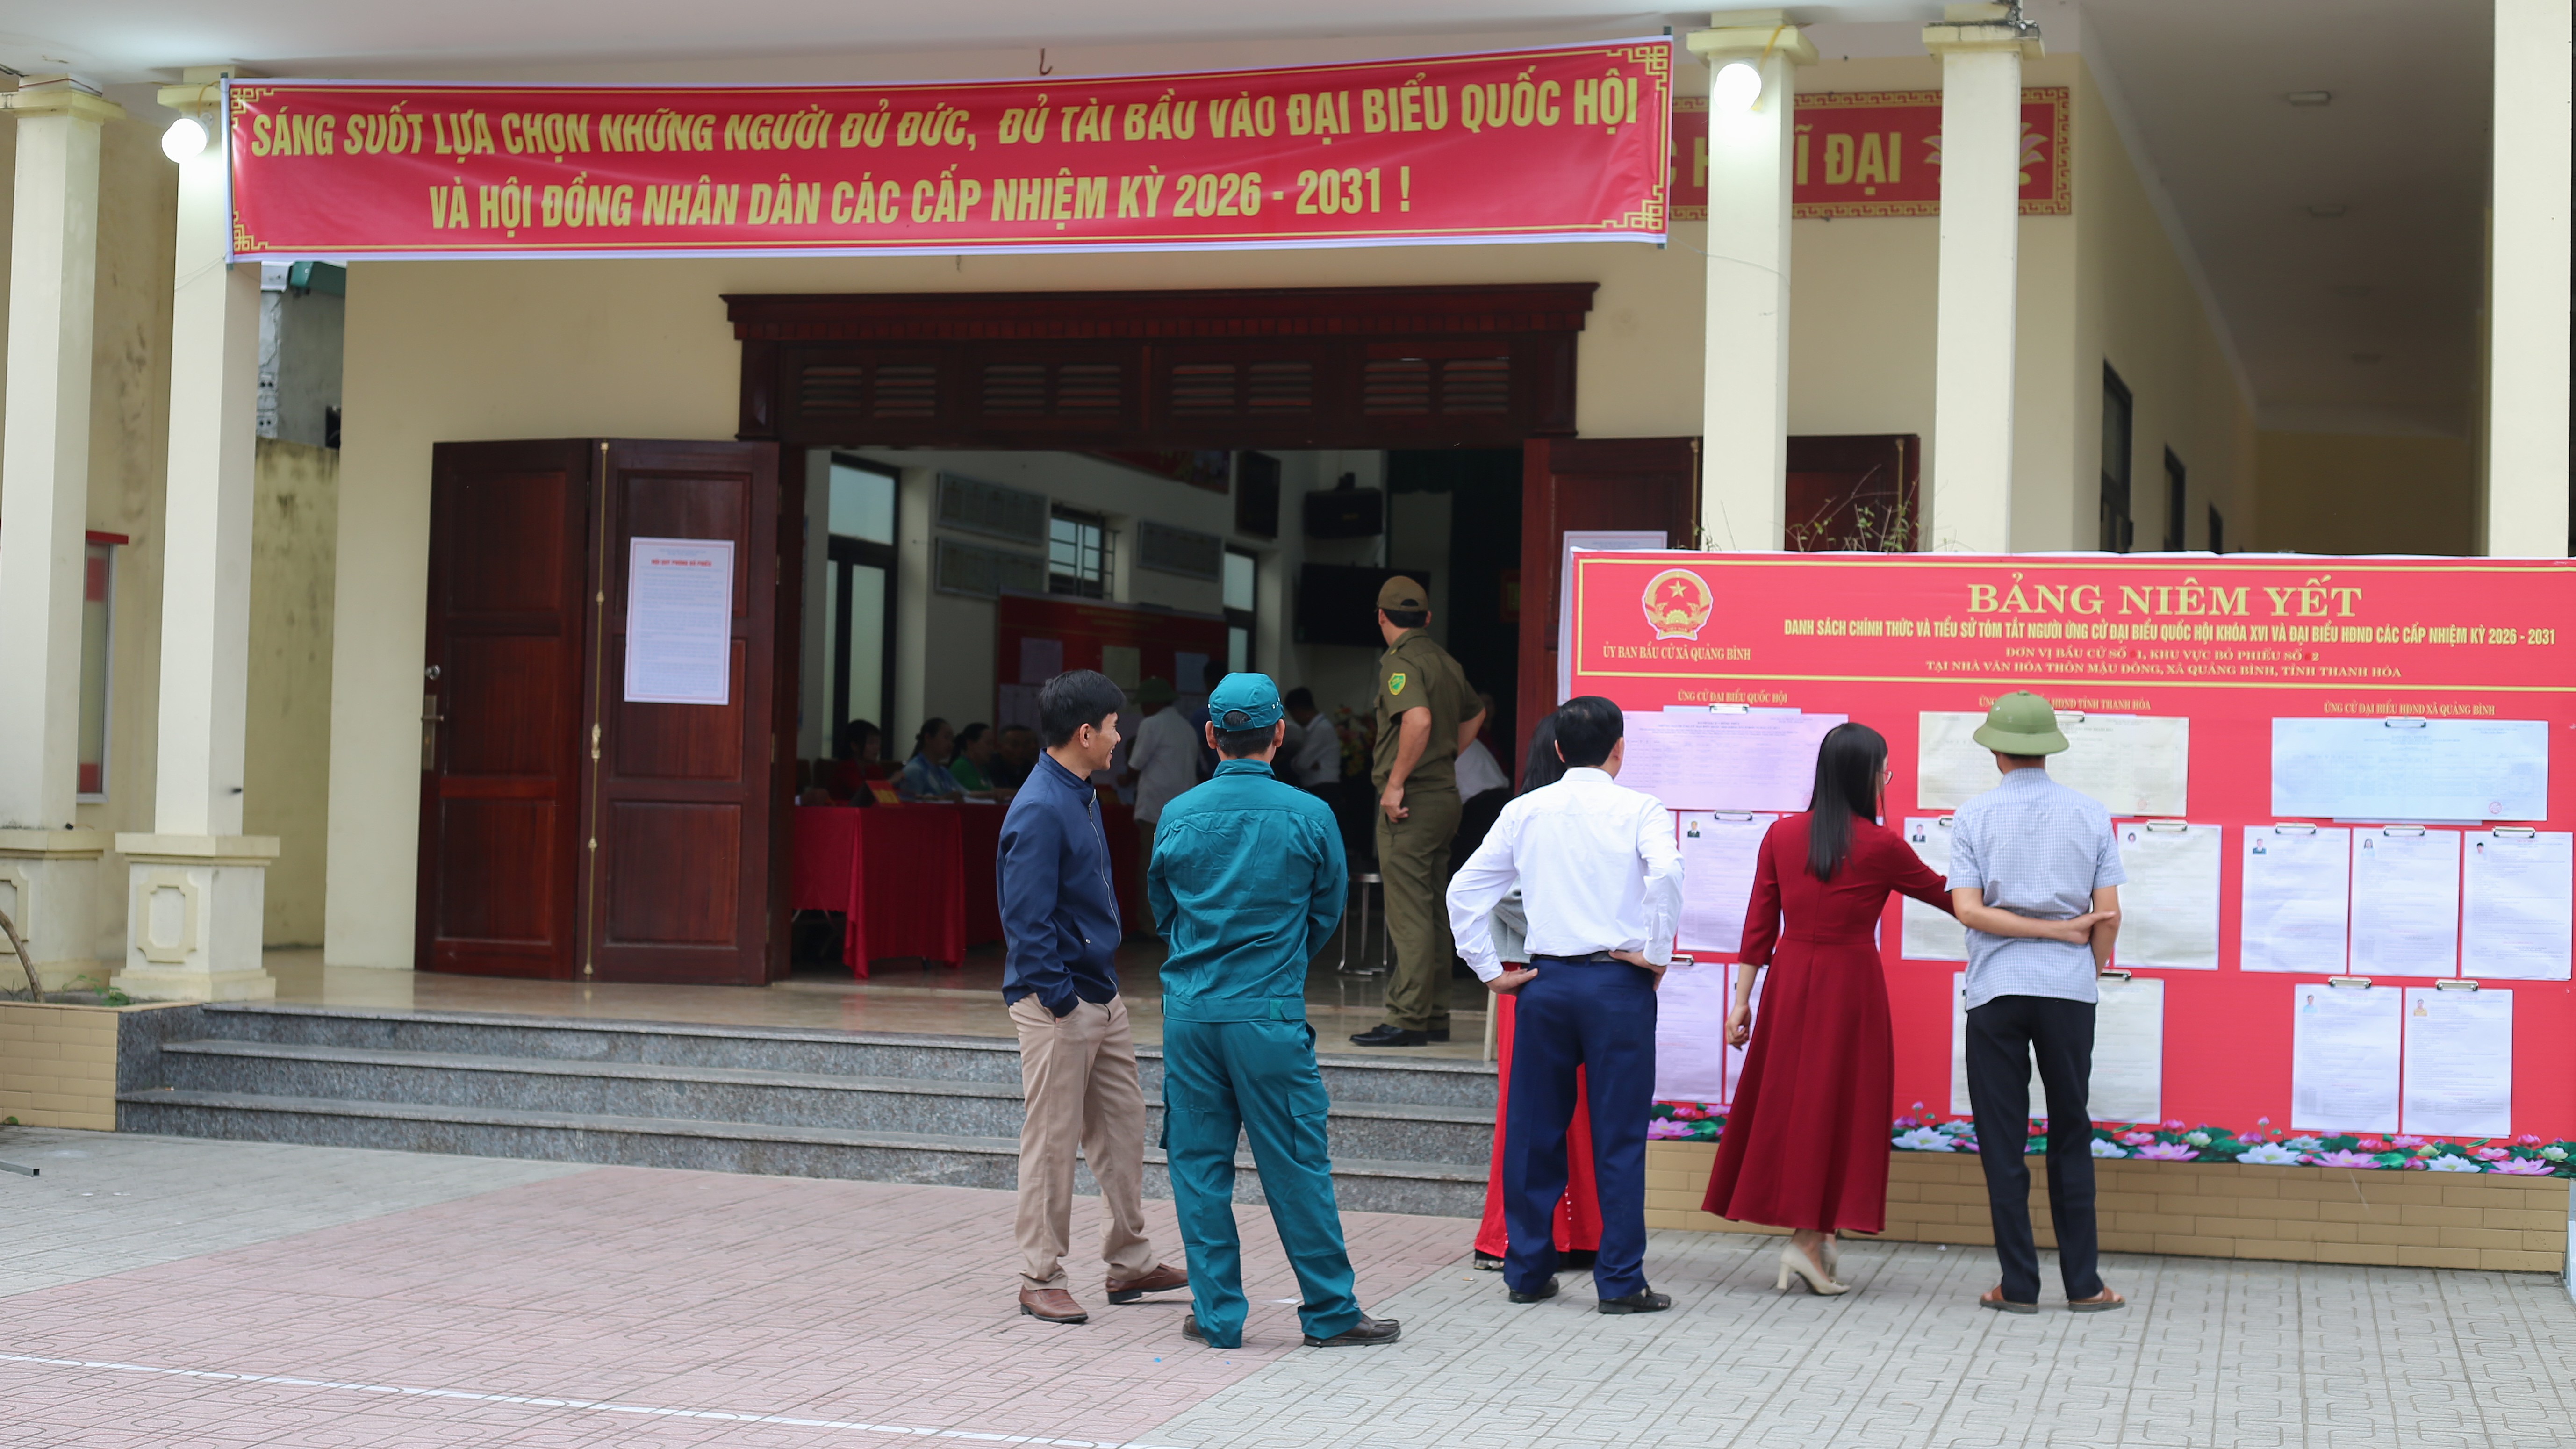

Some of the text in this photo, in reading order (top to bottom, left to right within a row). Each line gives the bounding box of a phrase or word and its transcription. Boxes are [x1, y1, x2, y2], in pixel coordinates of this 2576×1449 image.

[251, 65, 1638, 164] SÁNG SUỐT LỰA CHỌN NHỮNG NGƯỜI ĐỦ ĐỨC, ĐỦ TÀI BẦU VÀO ĐẠI BIỂU QUỐC HỘI
[1823, 131, 1902, 196] ĐẠI
[429, 163, 1413, 238] VÀ HỘI ĐỒNG NHÂN DÂN CÁC CẤP NHIỆM KỲ 2026 - 2031 !
[1967, 571, 2363, 617] BẢNG NIÊM YẾT
[1784, 619, 1815, 636] DANH
[1817, 617, 1847, 636] SÁCH
[1849, 617, 1883, 637] CHÍNH
[1886, 617, 1914, 638] THỨC
[1916, 617, 1931, 638] VÀ
[1933, 615, 1958, 638] TIỂU
[1960, 616, 1977, 638] SỬ
[1979, 618, 2003, 639] TÓM
[2005, 616, 2025, 639] TẮT
[2027, 618, 2062, 639] NGƯỜI
[2065, 619, 2089, 640] ỨNG
[2091, 617, 2109, 640] CỬ
[2110, 623, 2129, 644] ĐẠI
[2131, 617, 2158, 641] BIỂU
[2160, 618, 2191, 643] QUỐC
[2194, 621, 2214, 645] HỘI
[2216, 621, 2247, 642] KHÓA
[2250, 624, 2269, 642] XVI
[2271, 622, 2287, 642] VÀ
[2289, 625, 2310, 646] ĐẠI
[2312, 619, 2339, 643] BIỂU
[2340, 625, 2374, 644] HĐND
[2375, 623, 2400, 644] CÁC
[2402, 621, 2427, 644] CẤP
[2428, 623, 2468, 648] NHIỆM
[2470, 623, 2486, 645] KỲ
[2488, 627, 2518, 645] 2026
[2527, 628, 2556, 645] 2031
